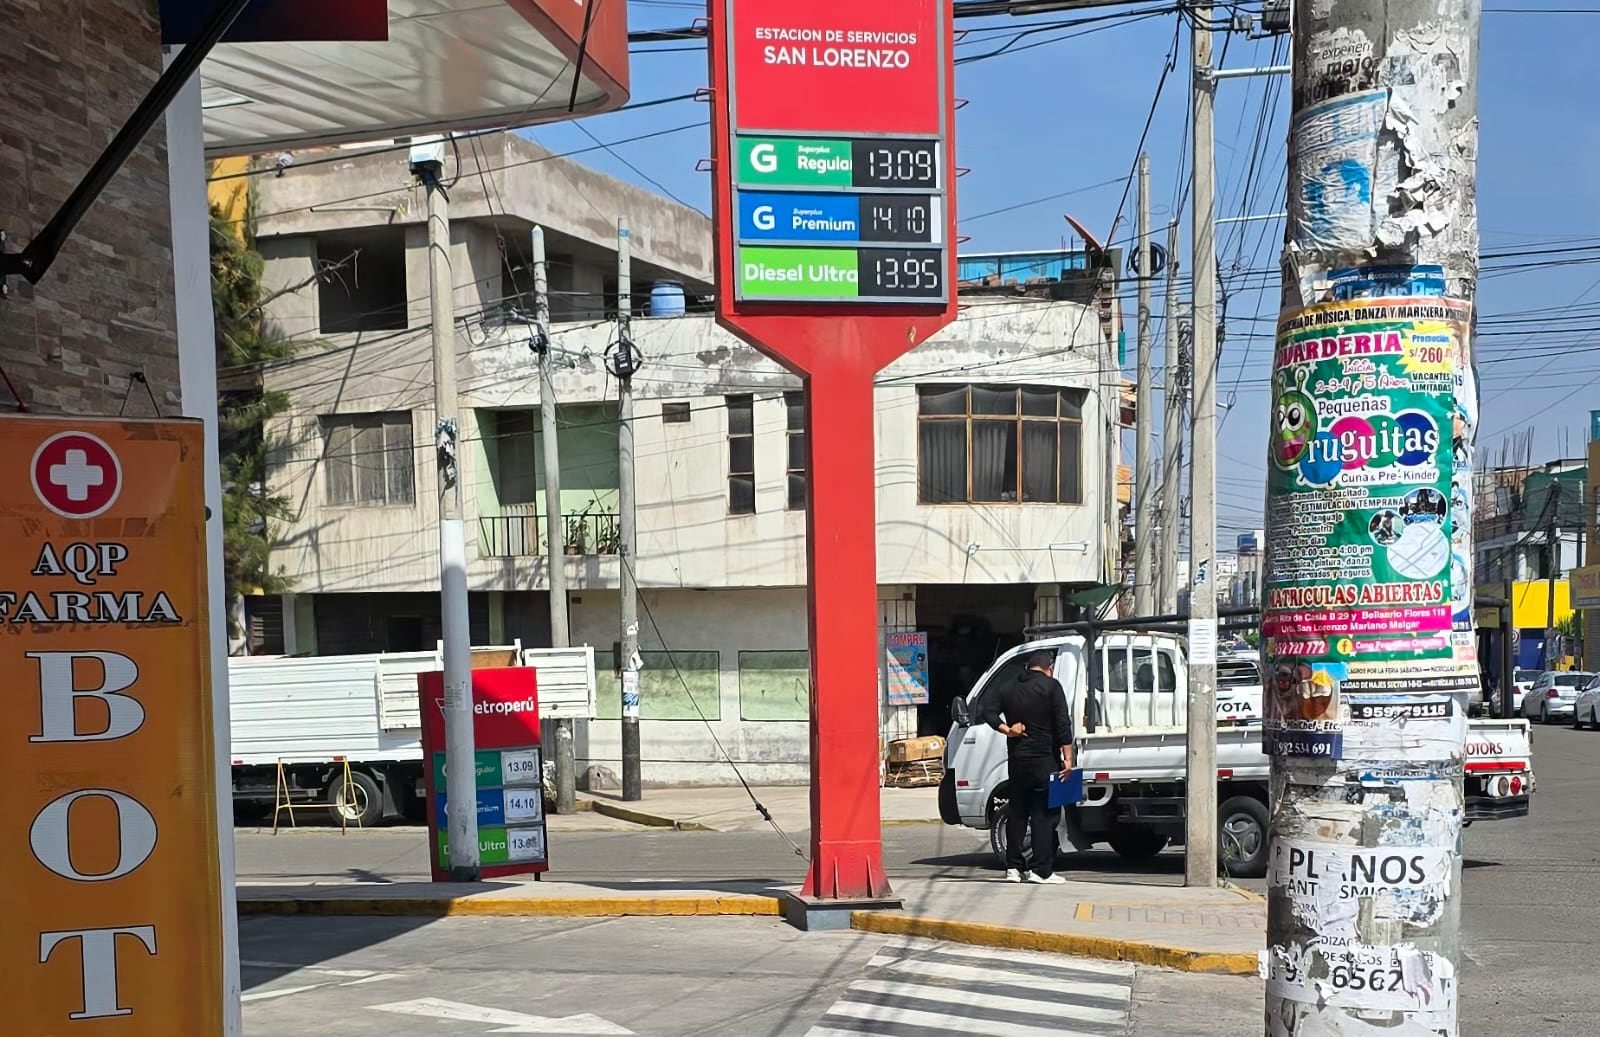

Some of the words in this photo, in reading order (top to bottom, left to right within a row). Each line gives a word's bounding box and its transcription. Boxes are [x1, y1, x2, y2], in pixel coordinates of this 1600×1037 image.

[755, 28, 822, 42] ESTACION
[825, 30, 844, 42] DE
[847, 31, 917, 44] SERVICIOS
[764, 46, 806, 65] SAN
[812, 48, 910, 68] LORENZO
[750, 144, 777, 173] G
[869, 149, 932, 181] 13.09
[752, 205, 775, 230] G
[792, 216, 856, 232] Premium
[744, 264, 803, 282] Diesel
[876, 258, 938, 288] 13.95
[1354, 306, 1387, 320] DANZA
[1412, 372, 1450, 380] VACANTES
[1412, 384, 1452, 392] LIMITADAS
[1318, 396, 1387, 416] Pequeñas
[1342, 473, 1369, 482] Cuna
[32, 542, 128, 584] AQP
[1360, 582, 1442, 604] ABIERTAS
[1404, 609, 1430, 618] Flores
[1314, 623, 1348, 632] Lorenzo
[1350, 622, 1387, 630] Mariano
[472, 696, 534, 716] etroperú
[1216, 702, 1252, 713] YOTA
[1312, 743, 1331, 755] 691
[1466, 742, 1503, 756] OTORS
[508, 760, 534, 772] 13.09
[510, 798, 534, 809] 14.10
[480, 842, 506, 852] Ultra
[1289, 848, 1426, 884] PLNOS
